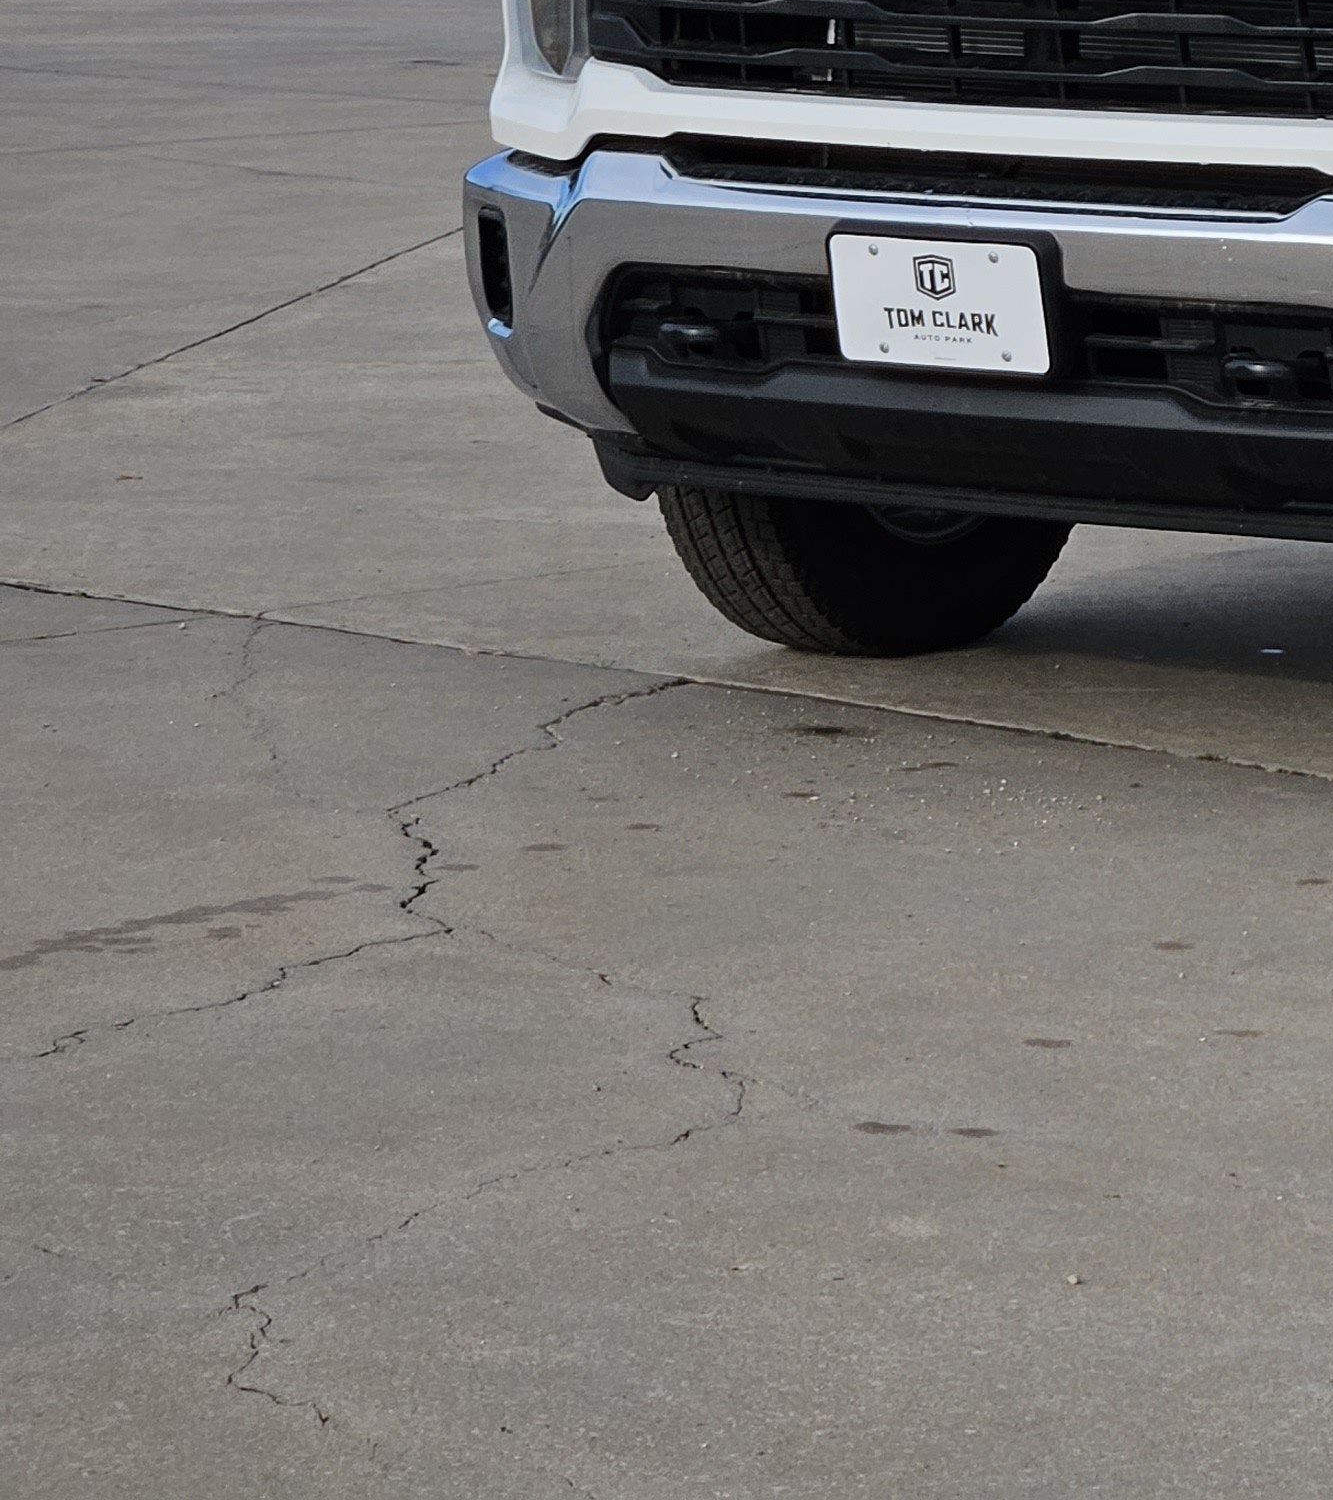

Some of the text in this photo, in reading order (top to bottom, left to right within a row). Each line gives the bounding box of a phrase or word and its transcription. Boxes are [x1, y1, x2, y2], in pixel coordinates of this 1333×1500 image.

[919, 263, 950, 291] TC
[883, 307, 999, 337] TOM CLARK
[913, 333, 973, 344] AUTO PARK
